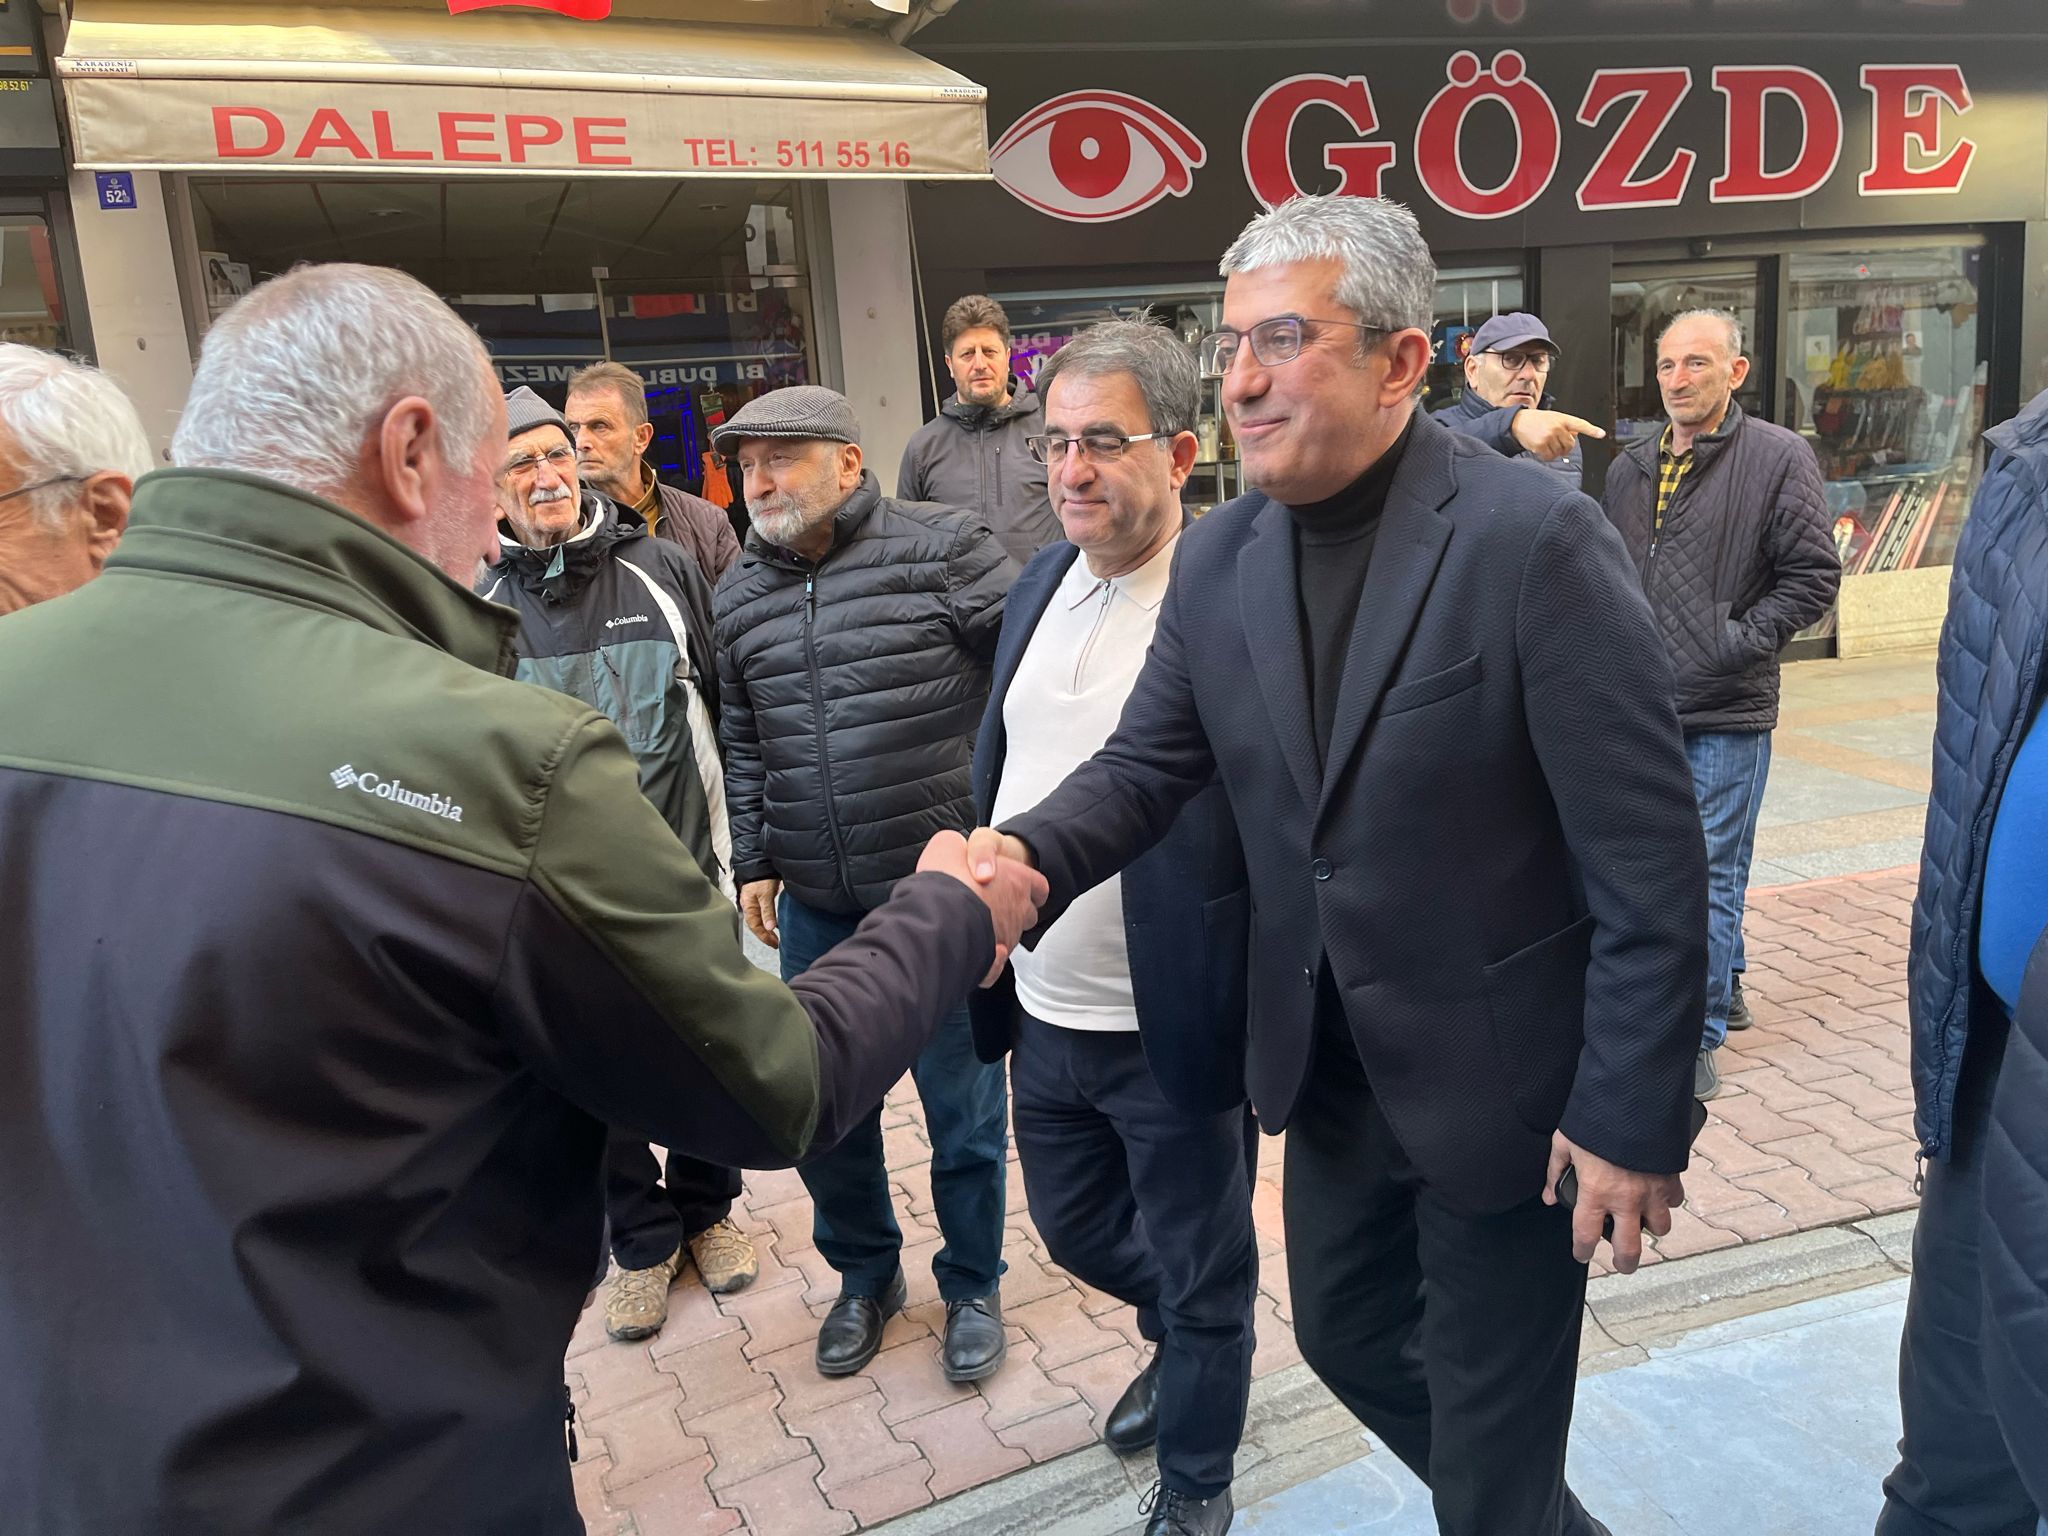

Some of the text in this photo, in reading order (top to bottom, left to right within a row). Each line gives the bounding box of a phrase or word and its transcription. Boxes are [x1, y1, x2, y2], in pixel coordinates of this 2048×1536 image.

[212, 106, 911, 168] DALEPE TEL: 511 55 16
[1241, 49, 1977, 220] GÖZDE
[613, 614, 649, 626] Columbia
[357, 772, 463, 823] Columbia
